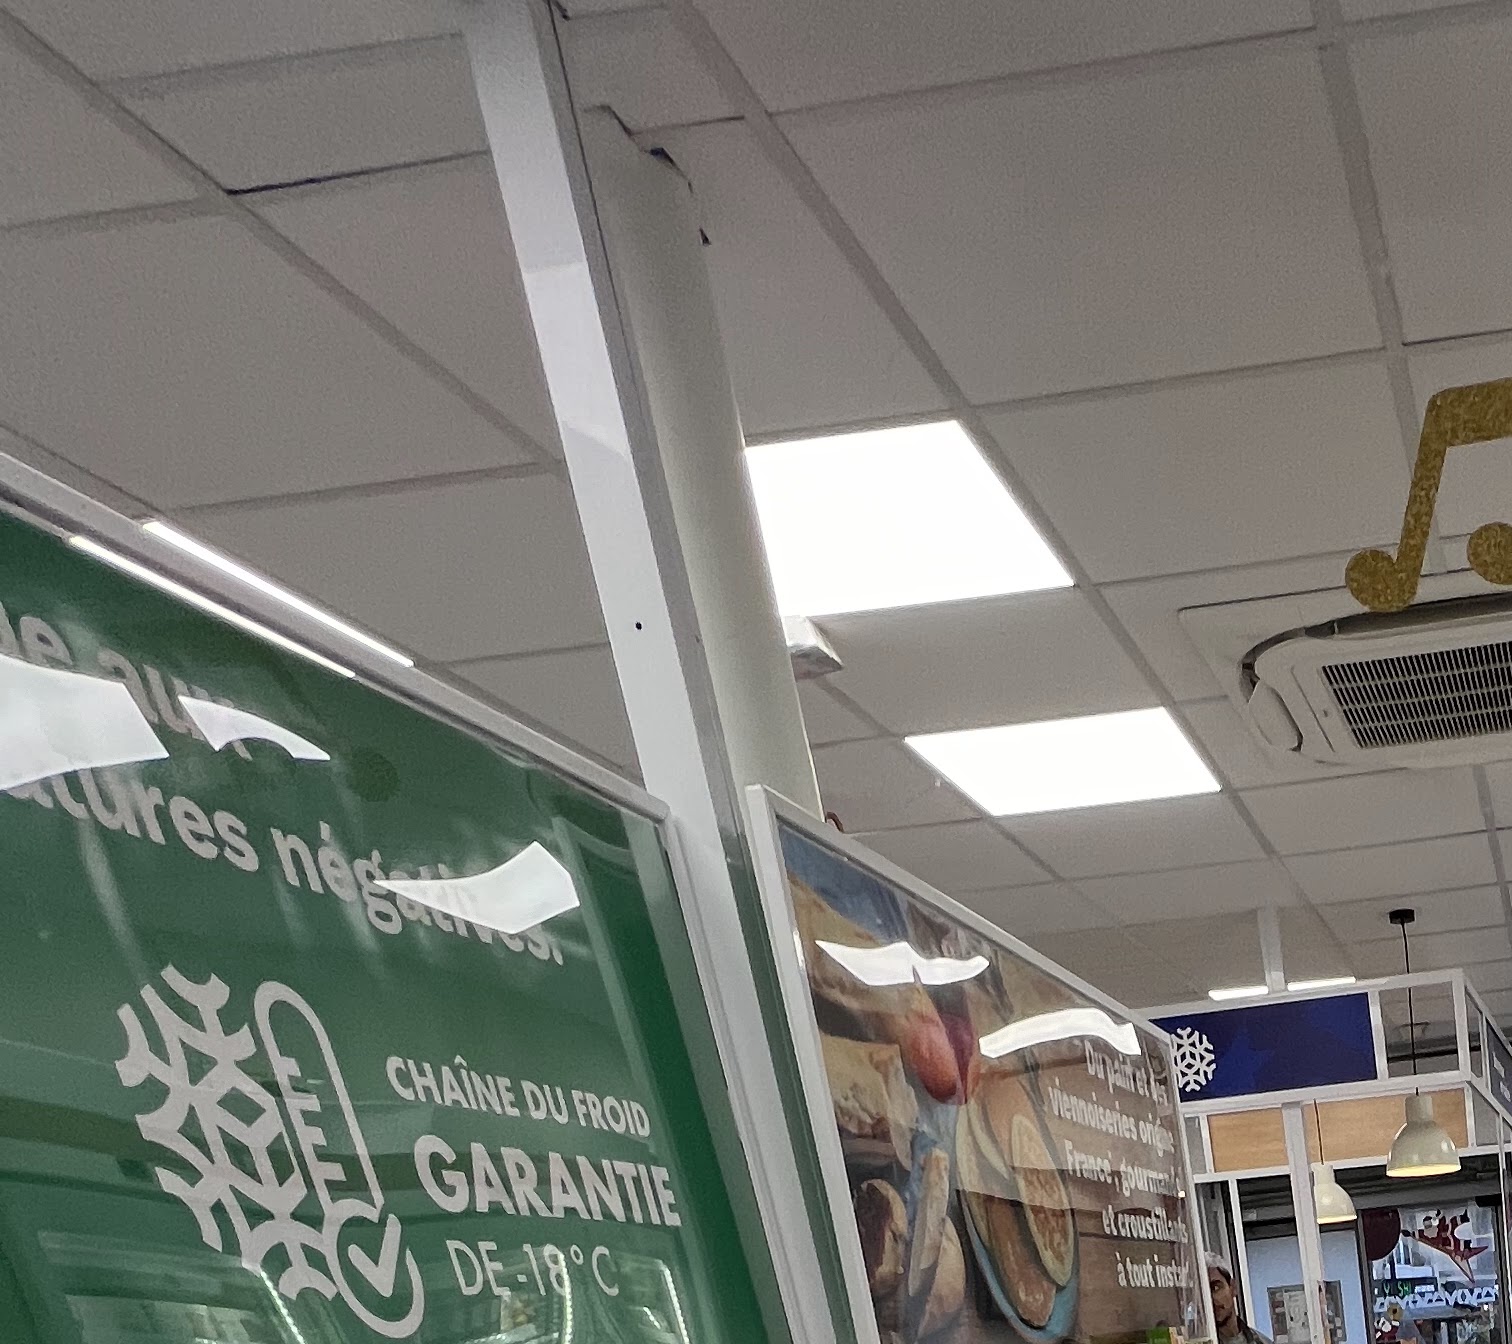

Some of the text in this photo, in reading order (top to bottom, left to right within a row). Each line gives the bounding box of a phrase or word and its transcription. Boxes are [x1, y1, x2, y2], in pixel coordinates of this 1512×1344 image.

[6, 765, 259, 872] tures
[386, 1056, 651, 1137] CHAÎNE DU FROID
[414, 1134, 682, 1226] GARANTIE
[447, 1240, 504, 1296] DE
